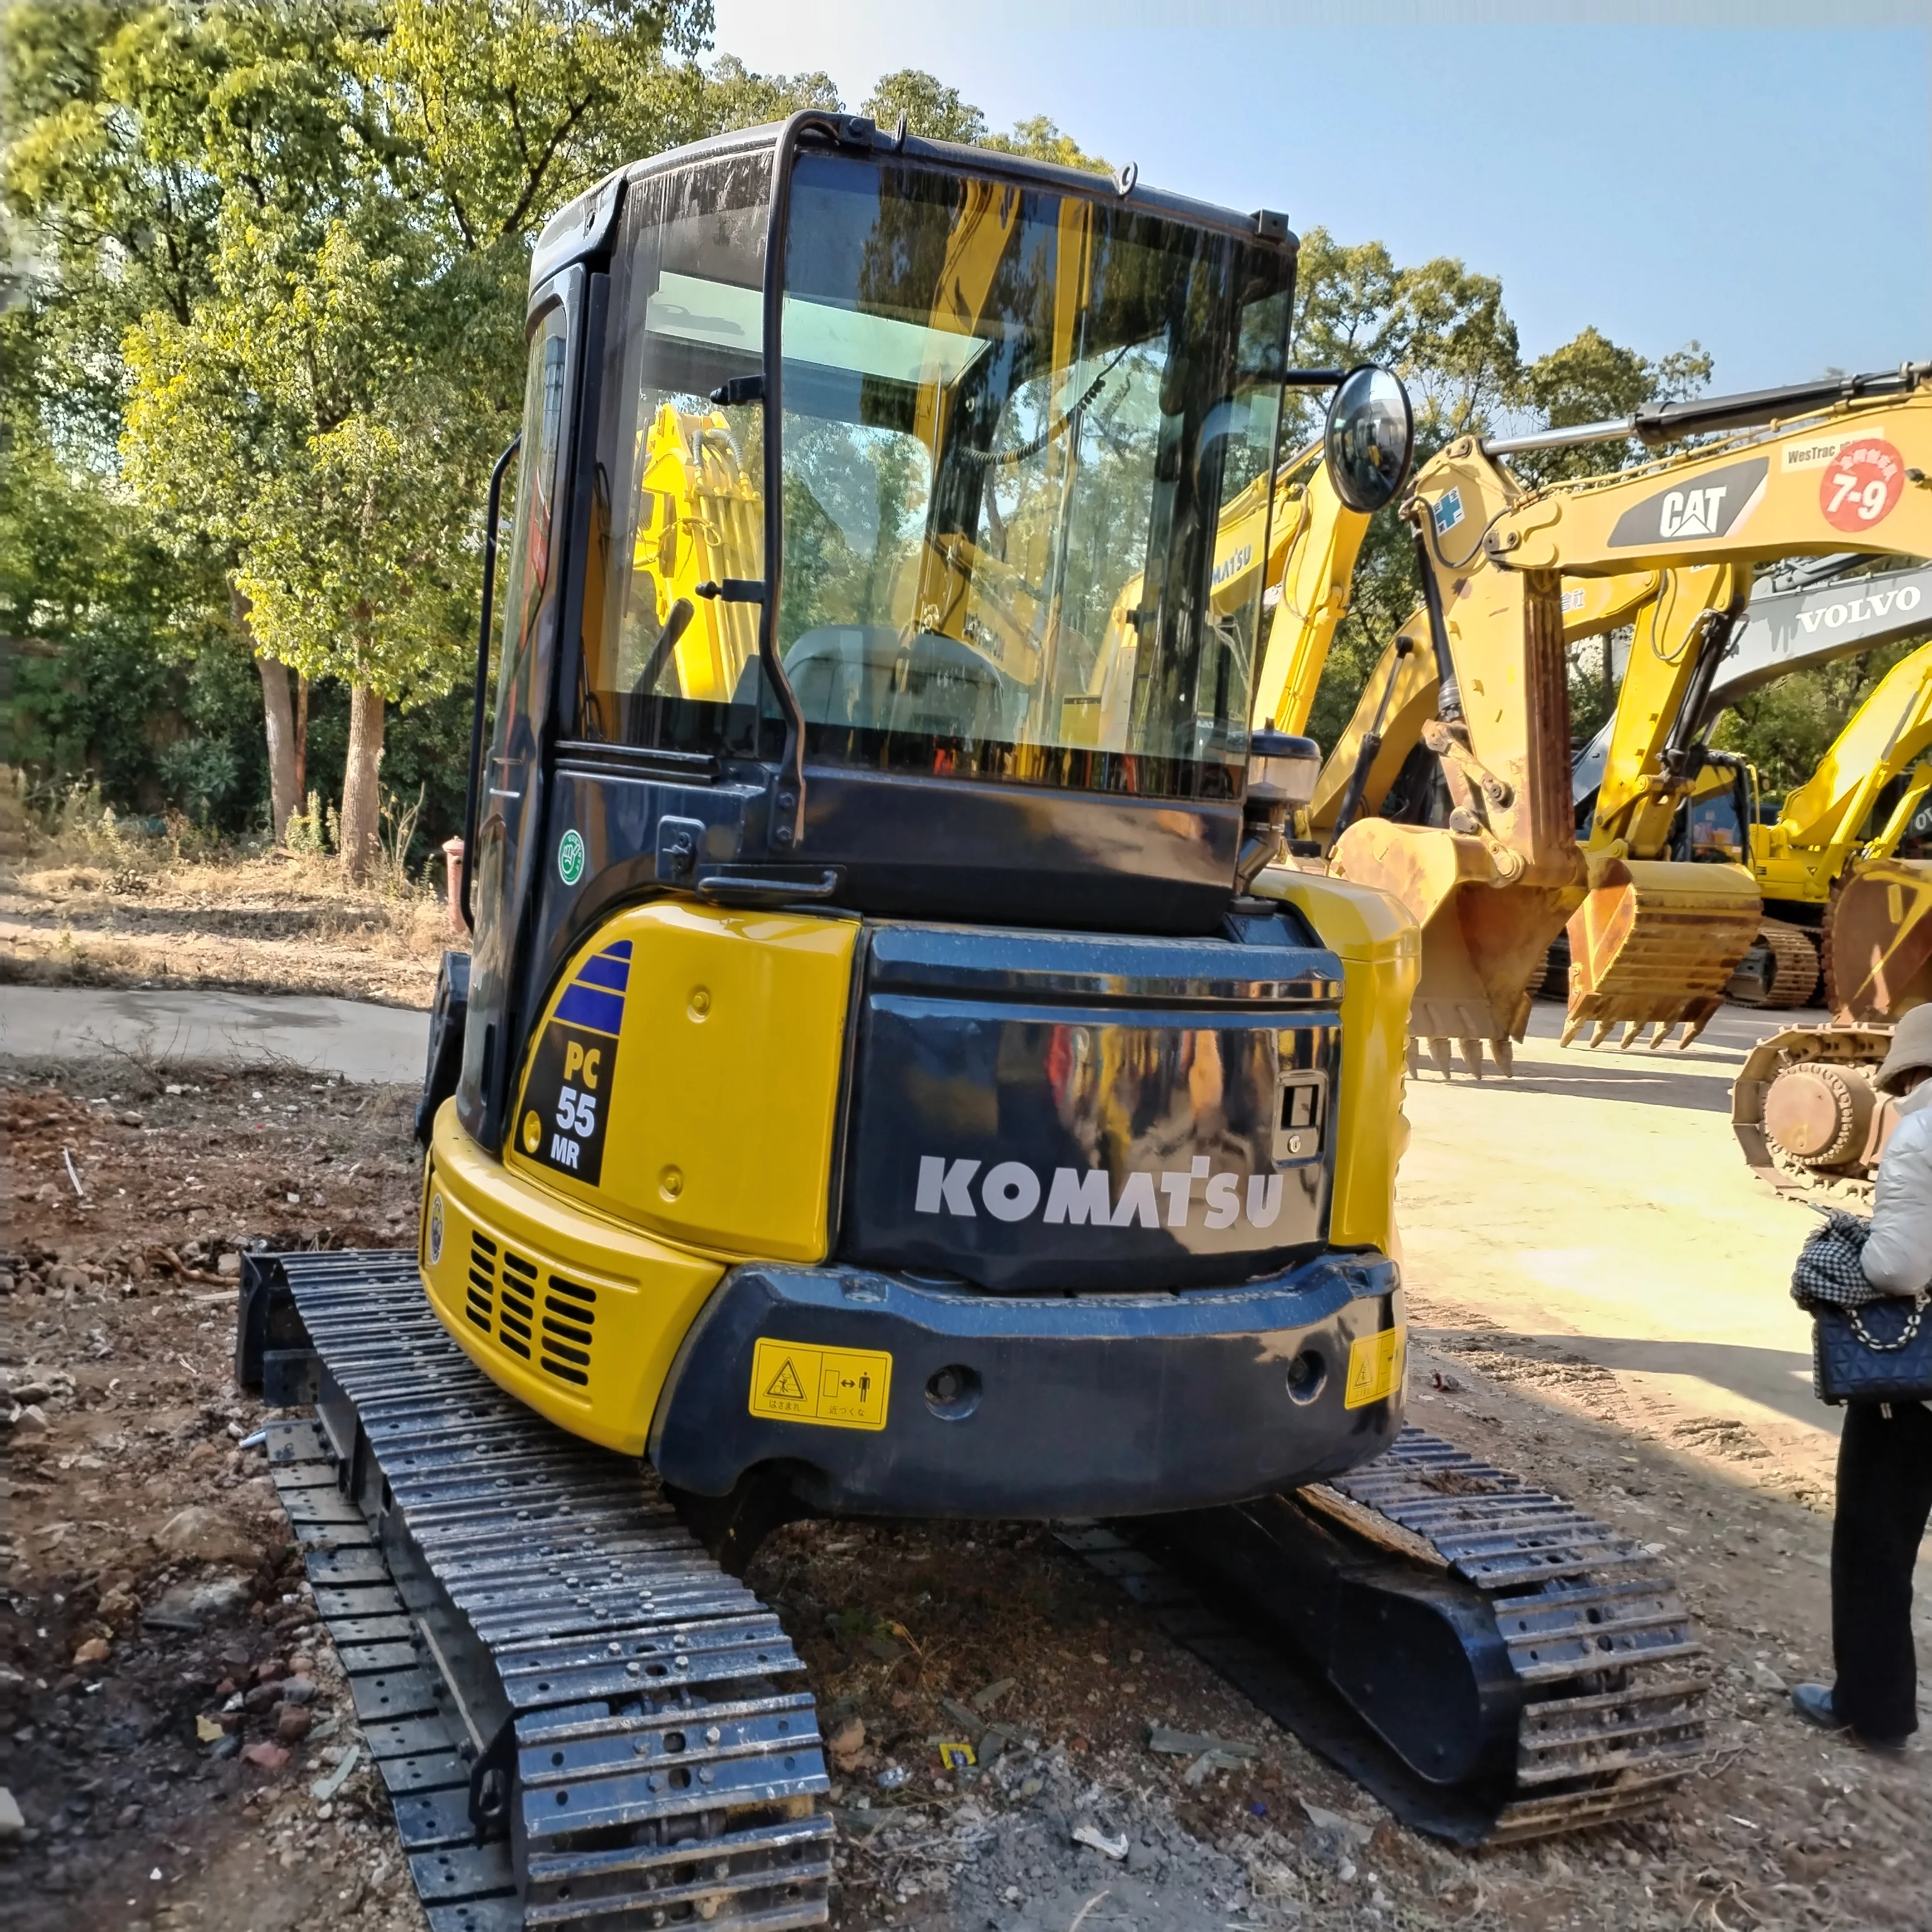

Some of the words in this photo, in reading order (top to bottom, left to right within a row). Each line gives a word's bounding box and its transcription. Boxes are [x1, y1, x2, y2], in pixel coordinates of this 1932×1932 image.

[1788, 445, 1835, 464] WesTrac
[1660, 486, 1727, 537] CAT
[1827, 472, 1888, 521] 7-9
[1211, 543, 1251, 586] MATSU
[1795, 586, 1921, 633] VOLVO
[564, 1041, 601, 1089] PC
[556, 1086, 596, 1137] 55
[551, 1134, 579, 1169] MR
[915, 1155, 1284, 1229] KOMATSU
[769, 1399, 801, 1412] はさまれ
